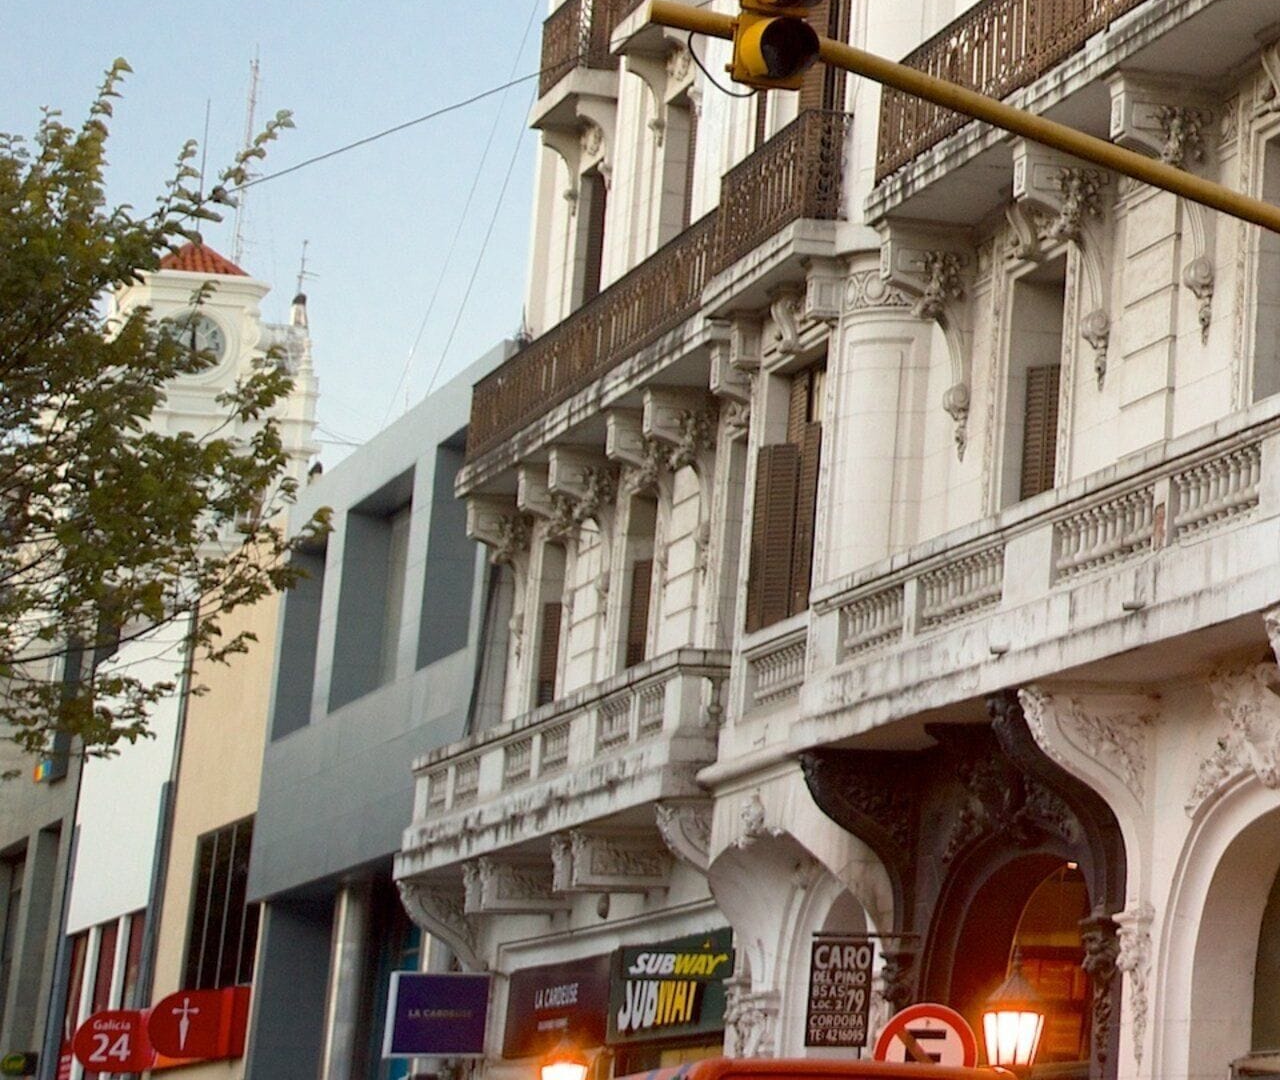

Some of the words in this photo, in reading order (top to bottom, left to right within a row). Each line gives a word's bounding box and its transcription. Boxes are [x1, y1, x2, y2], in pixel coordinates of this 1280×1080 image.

[628, 953, 729, 976] SUBWAY
[814, 944, 871, 970] CARO
[812, 970, 833, 984] DEL
[834, 970, 866, 985] PINO
[535, 989, 544, 1010] LA
[845, 989, 865, 1014] 79
[93, 1019, 131, 1031] Galicia
[809, 1014, 864, 1028] CORDOBA
[88, 1033, 131, 1062] 24
